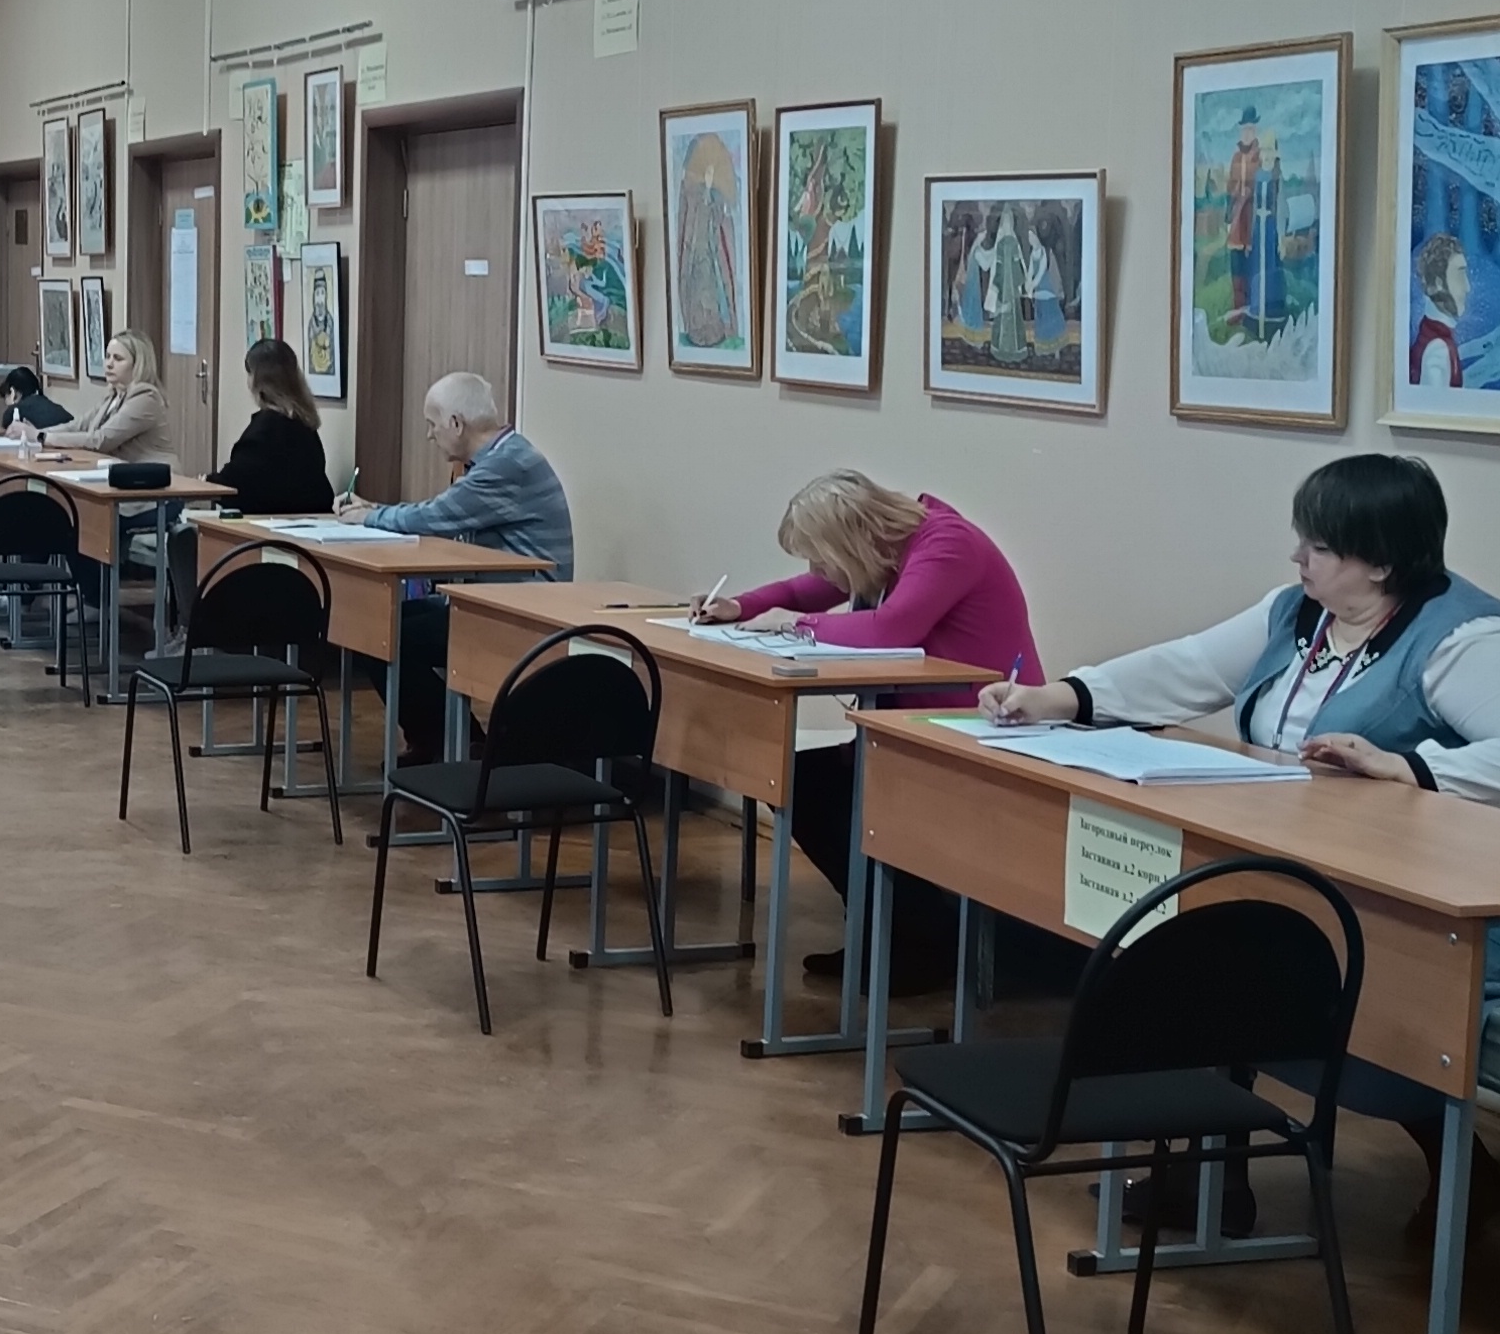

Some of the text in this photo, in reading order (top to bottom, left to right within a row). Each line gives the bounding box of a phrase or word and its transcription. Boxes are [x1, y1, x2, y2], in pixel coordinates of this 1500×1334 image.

[1079, 817, 1173, 858] Загородный переулок
[1081, 845, 1121, 870] Заставная
[1079, 872, 1120, 898] Заставная
